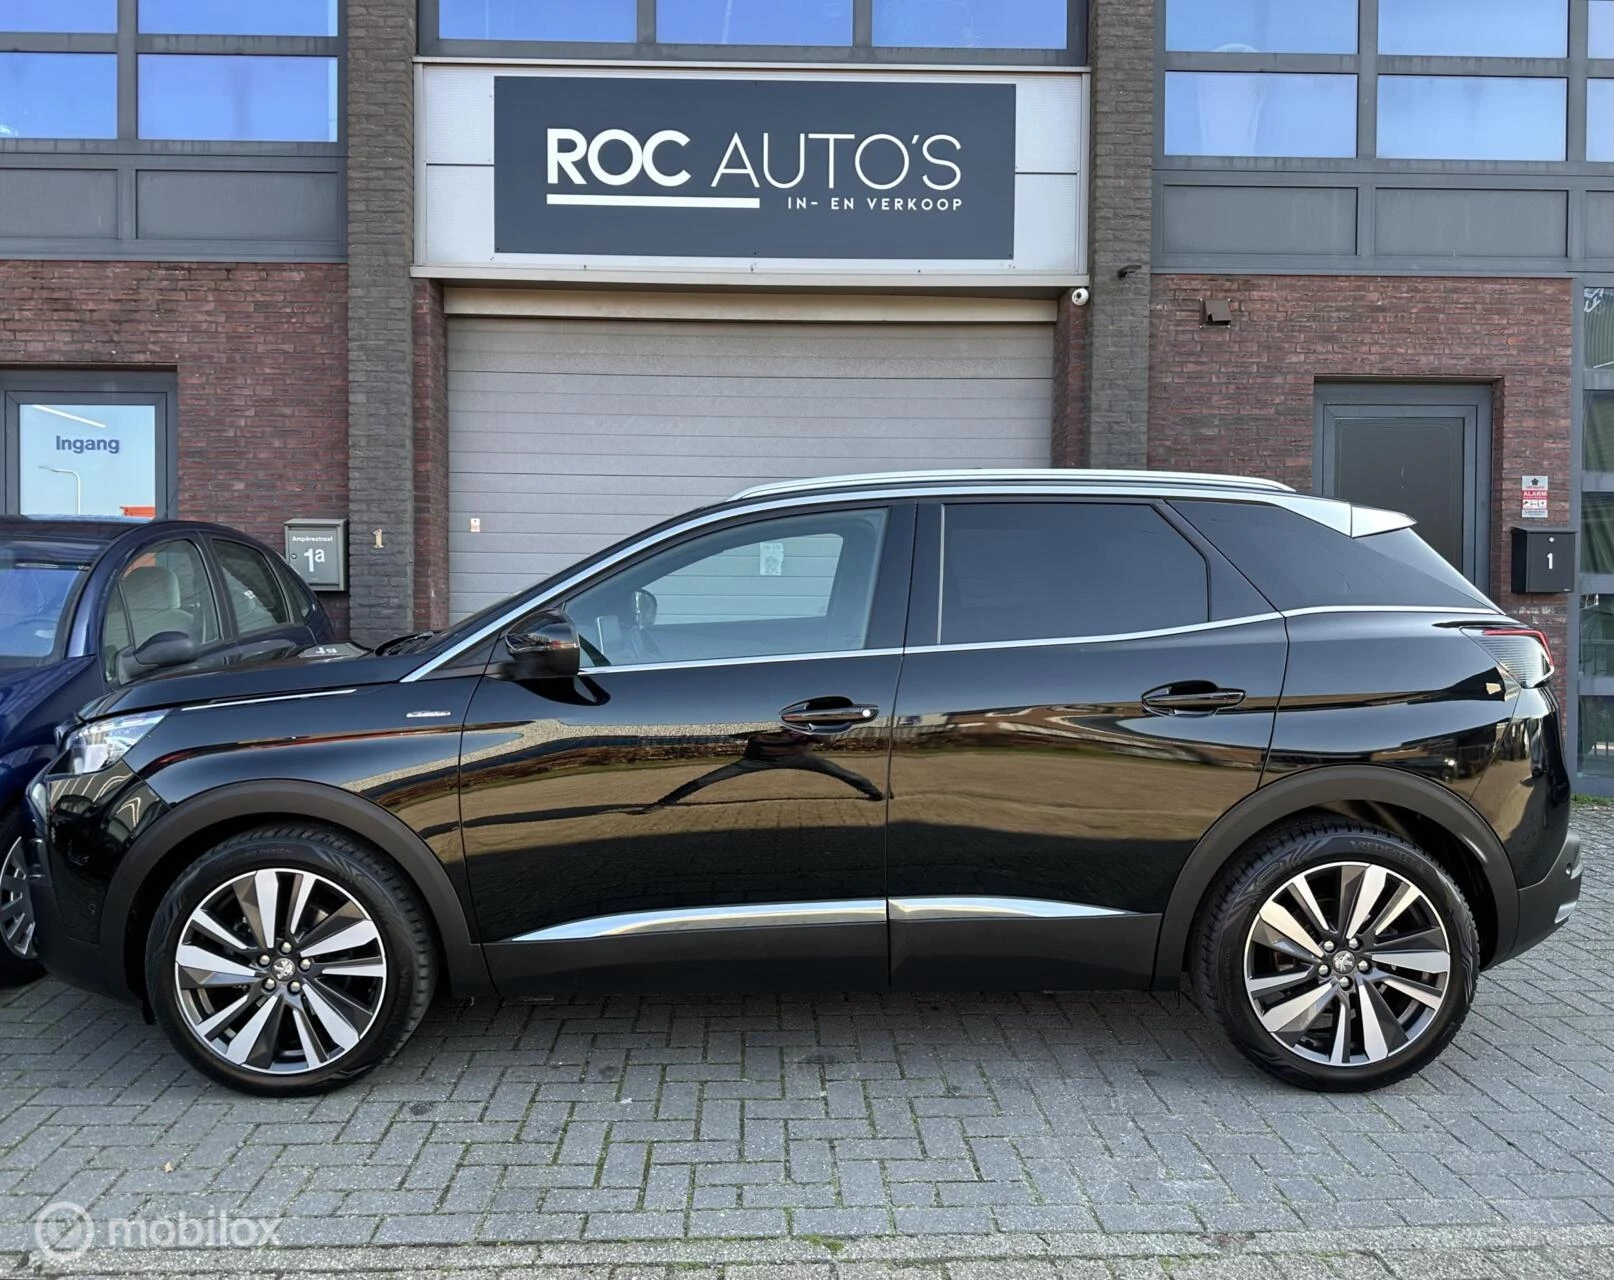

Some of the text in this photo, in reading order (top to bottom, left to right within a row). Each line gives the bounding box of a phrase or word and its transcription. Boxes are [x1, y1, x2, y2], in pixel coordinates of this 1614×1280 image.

[547, 129, 961, 190] ROC AUTO'S
[788, 197, 961, 210] IN- EN VERKOOP
[56, 435, 120, 454] Ingang
[372, 528, 384, 549] 1
[304, 548, 325, 572] 1a
[1547, 552, 1553, 570] 1
